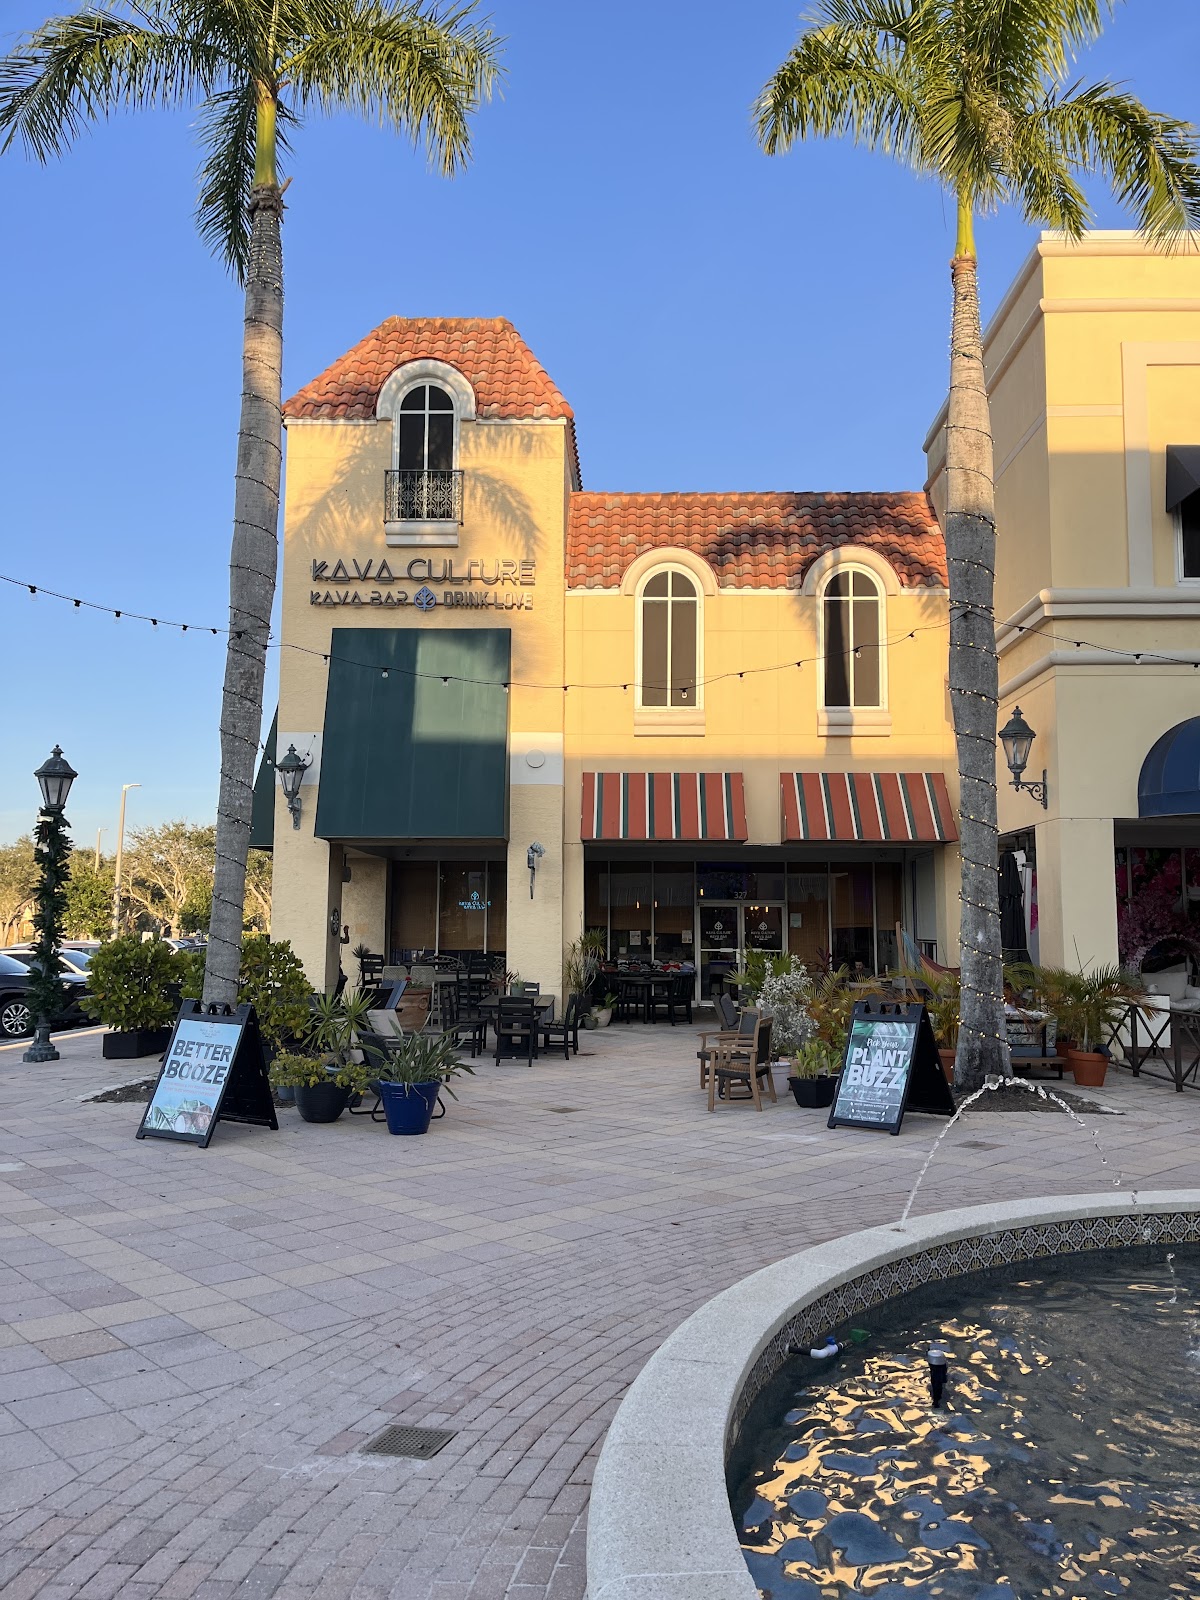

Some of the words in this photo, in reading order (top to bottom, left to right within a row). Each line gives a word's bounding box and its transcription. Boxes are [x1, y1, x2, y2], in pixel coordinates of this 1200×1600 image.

[312, 558, 395, 582] KAVA
[407, 558, 536, 586] CULTURE
[310, 590, 363, 606] KAVA
[370, 590, 408, 607] BAR
[443, 591, 489, 608] DRINK
[494, 591, 533, 610] LOVE
[734, 891, 748, 899] 327
[172, 1039, 233, 1063] BETTER
[867, 1037, 881, 1047] Pick
[851, 1047, 908, 1067] PLANT
[165, 1059, 228, 1086] BOOZE
[846, 1064, 904, 1089] BUZZ
